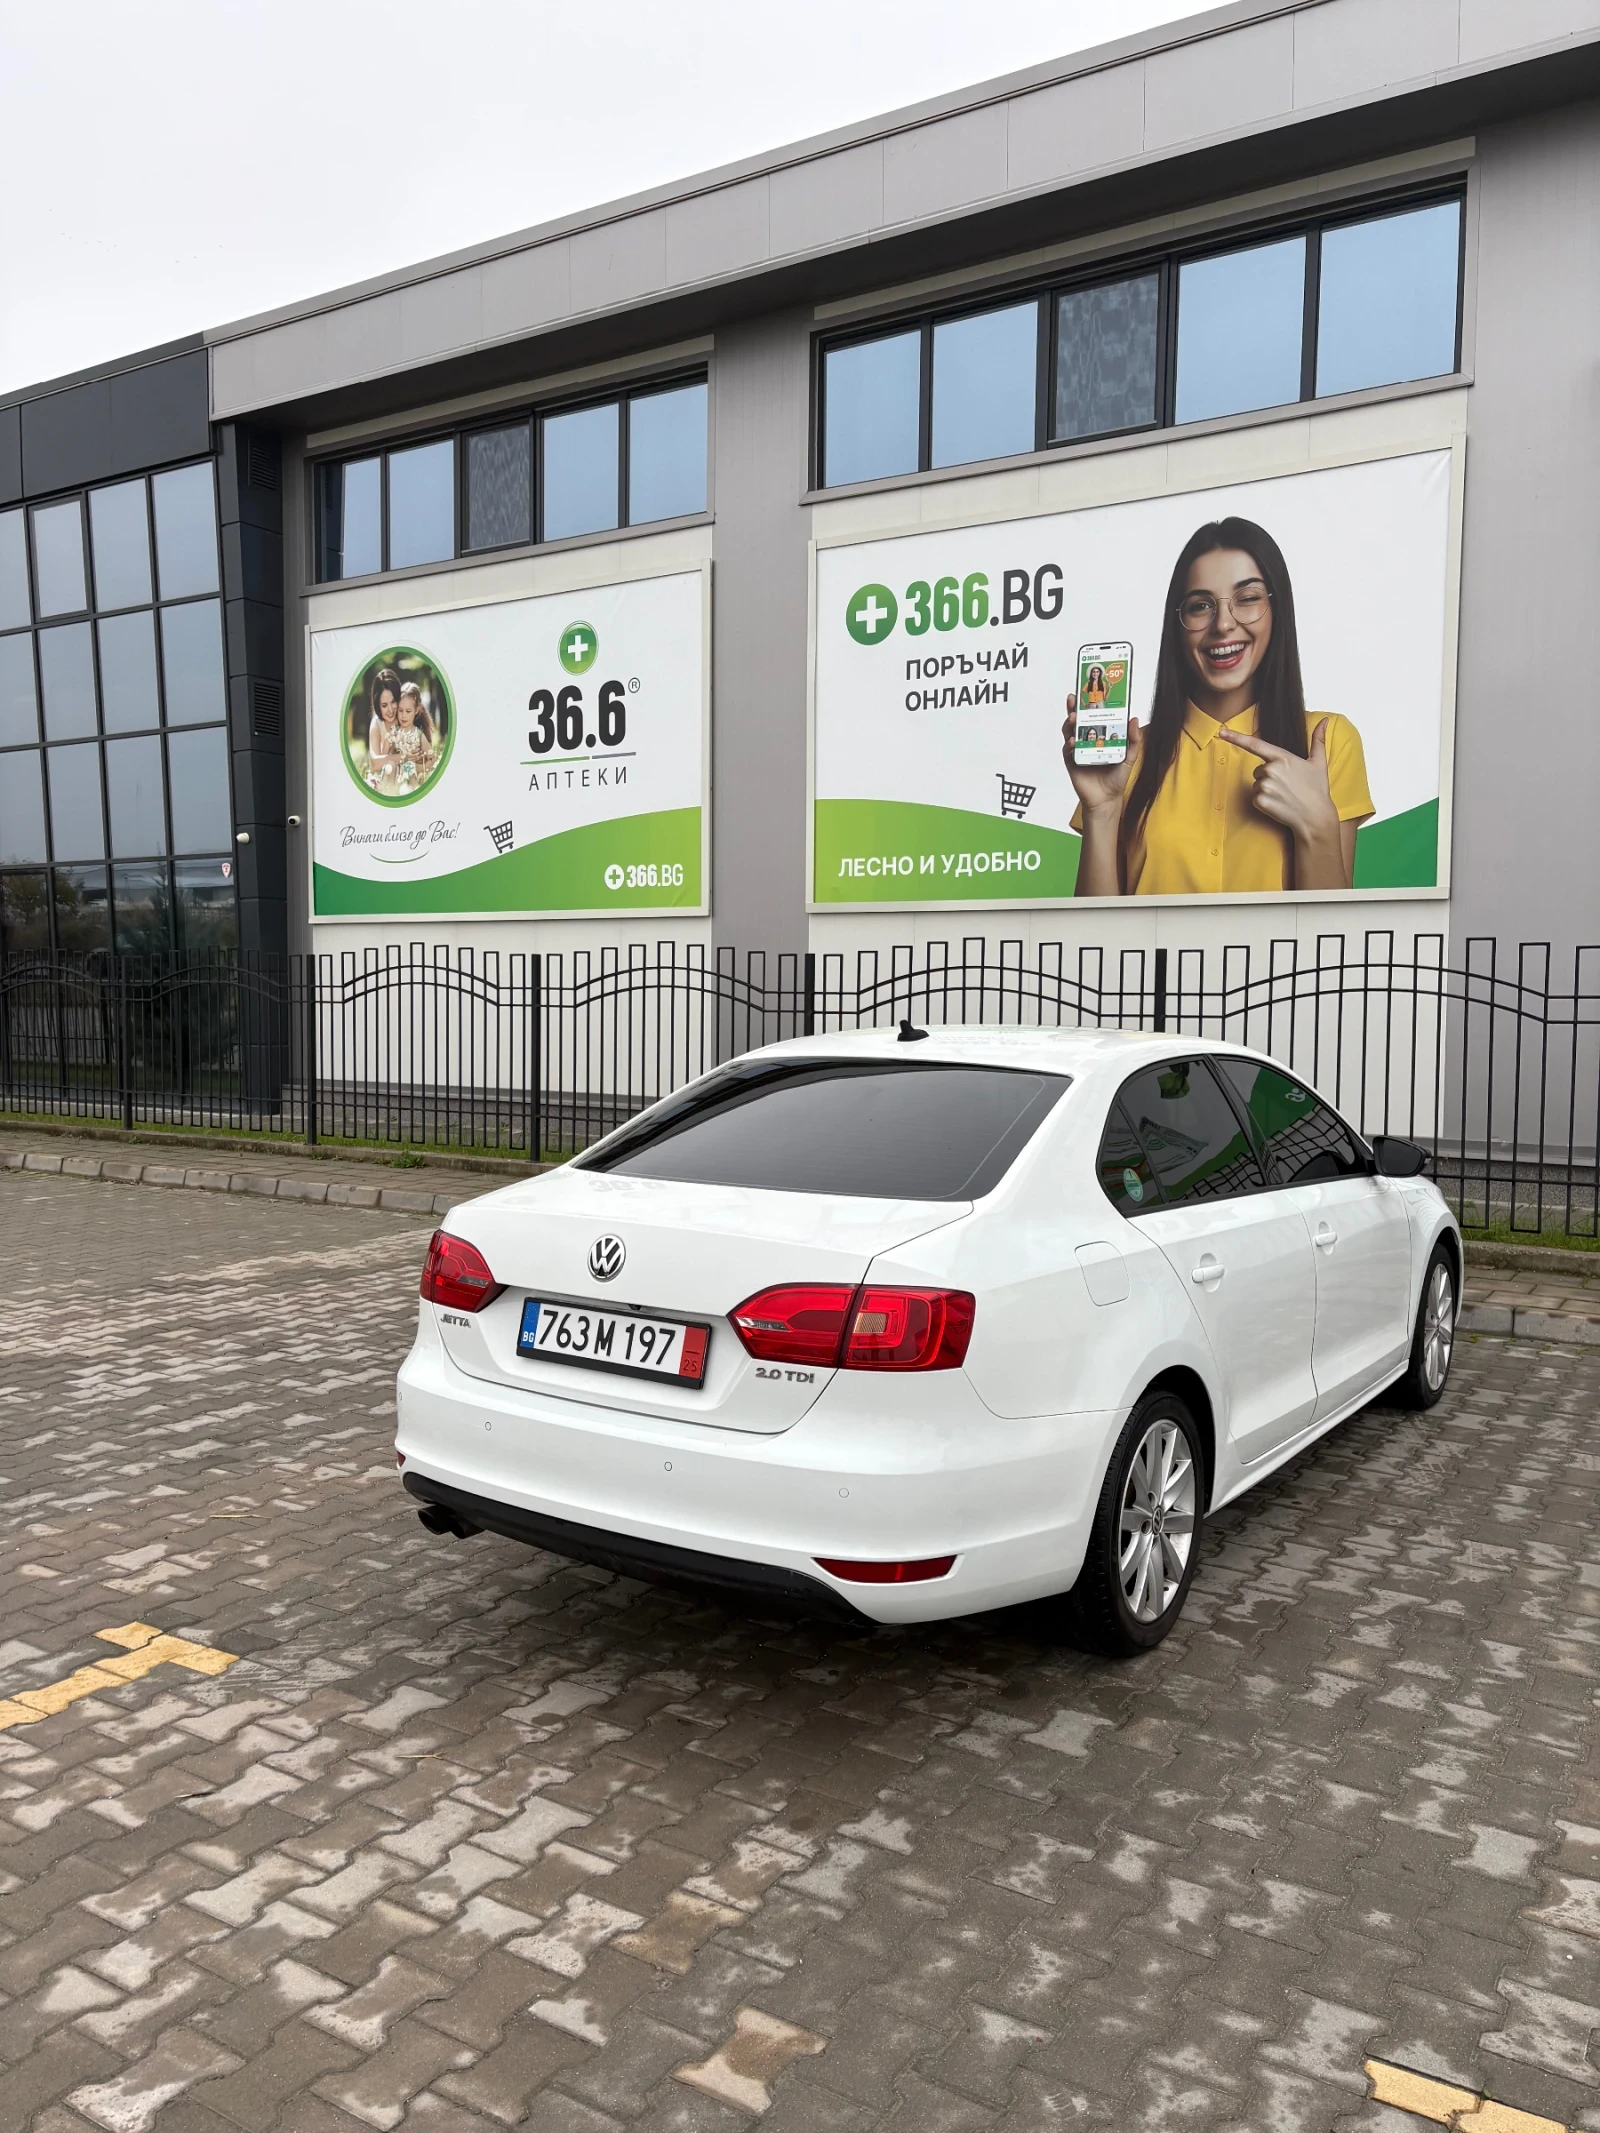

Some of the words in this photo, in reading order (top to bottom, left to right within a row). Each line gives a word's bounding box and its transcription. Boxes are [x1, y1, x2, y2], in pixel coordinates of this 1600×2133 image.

[904, 563, 1064, 636] 366.BG
[905, 641, 1029, 681] ПОРЪЧАЙ
[905, 678, 1009, 712] ОНЛАЙН
[528, 680, 626, 754] 36.6
[528, 766, 627, 792] АПТЕКИ
[340, 825, 384, 847] Винаги
[384, 824, 413, 842] близо
[409, 830, 427, 850] до
[428, 820, 461, 843] Вас!
[626, 863, 684, 888] 366.BG
[838, 856, 914, 877] ЛЕСНО
[919, 854, 935, 875] И
[941, 850, 1041, 878] УДОБНО
[440, 1313, 471, 1328] JETTA
[522, 1331, 535, 1343] BG
[538, 1309, 590, 1351] 763
[593, 1318, 616, 1357] M
[624, 1323, 676, 1366] 197
[683, 1359, 698, 1372] 25
[755, 1367, 782, 1380] 2.0
[784, 1370, 815, 1384] TDI
